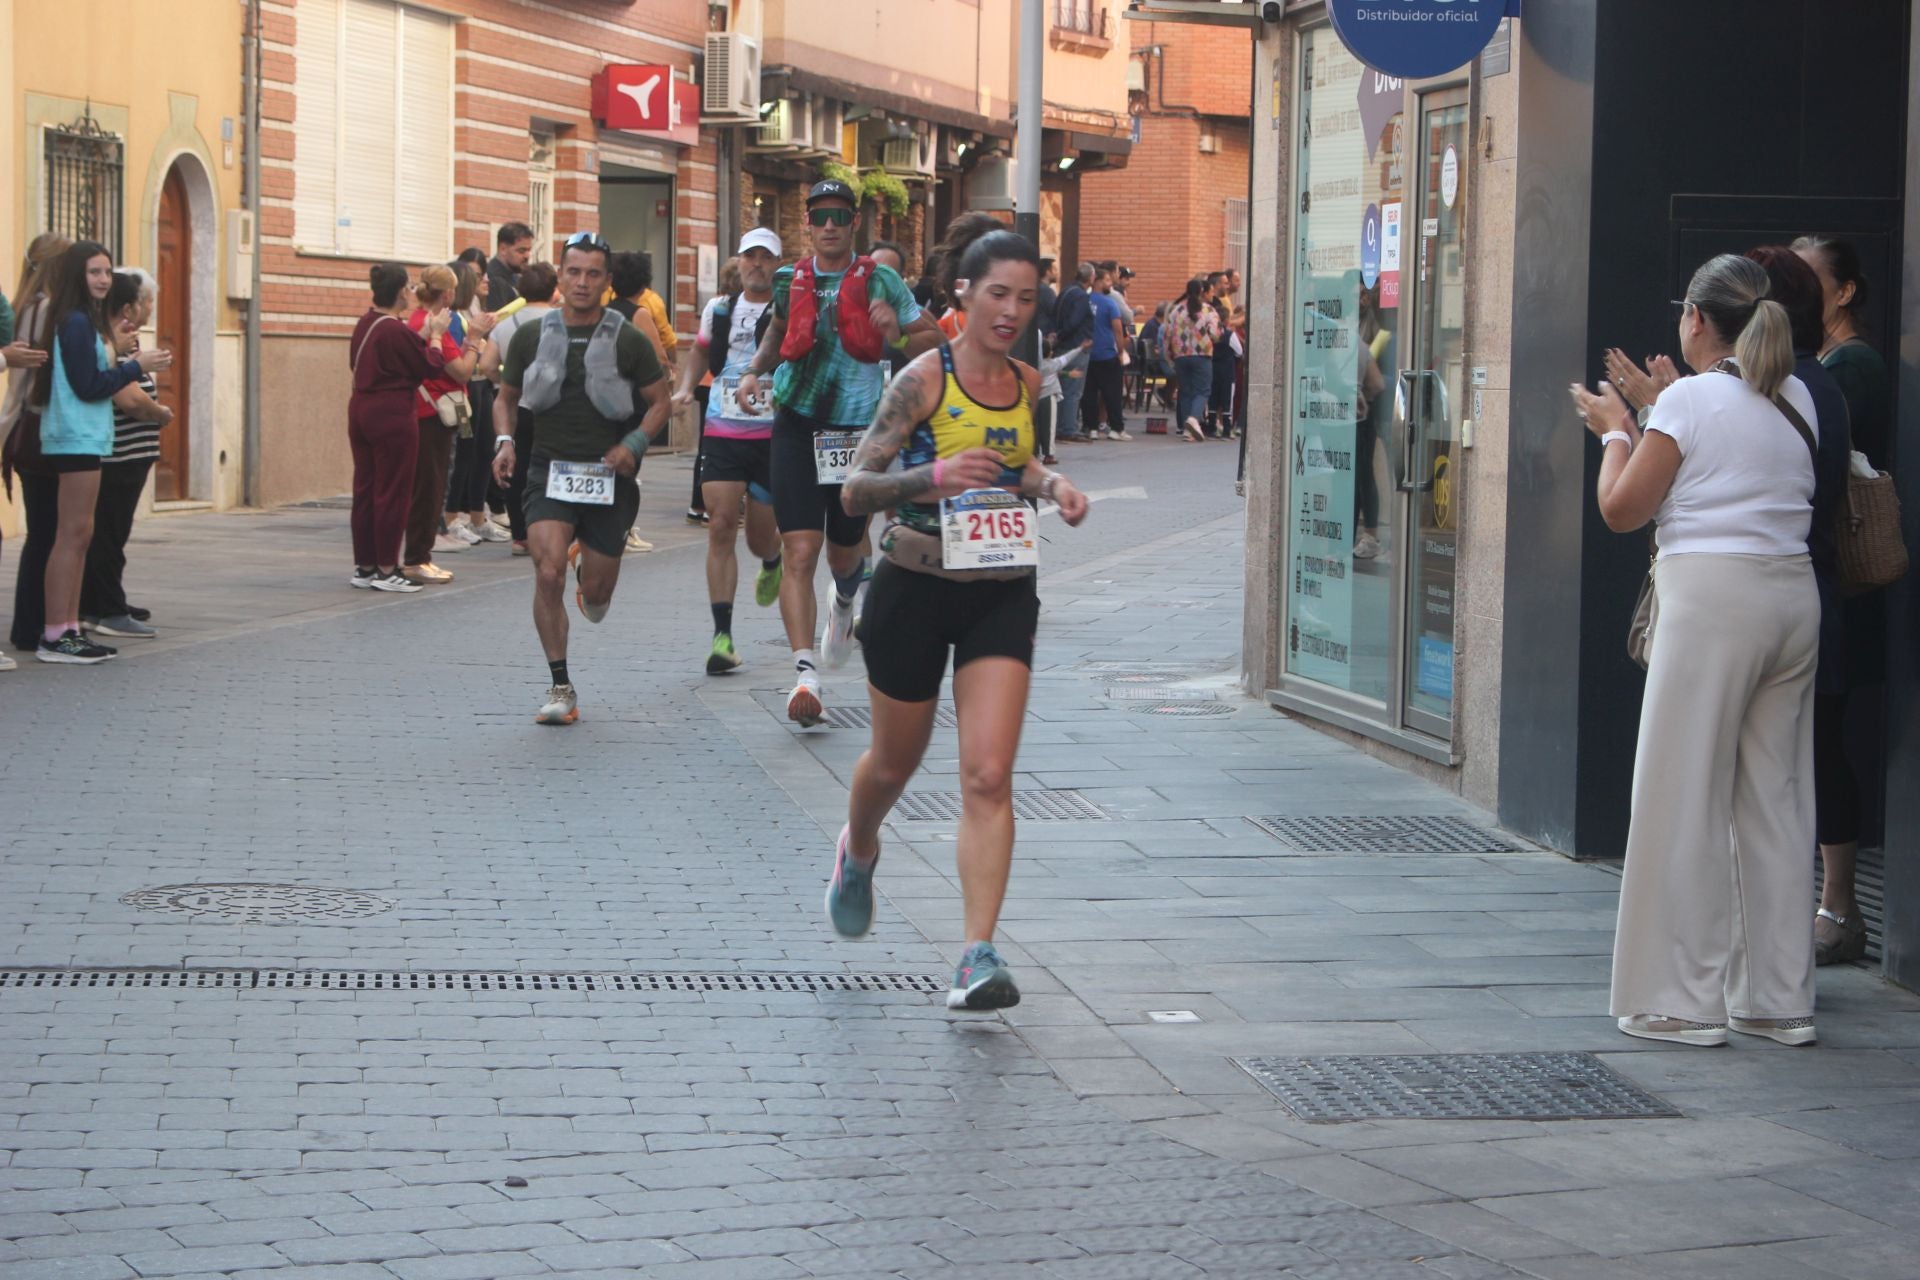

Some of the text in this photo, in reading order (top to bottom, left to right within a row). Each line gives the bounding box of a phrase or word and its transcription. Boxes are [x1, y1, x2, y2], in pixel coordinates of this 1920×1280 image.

[1357, 9, 1479, 22] Distribuidor oficial
[565, 476, 605, 495] 3283
[968, 512, 1025, 541] 2165
